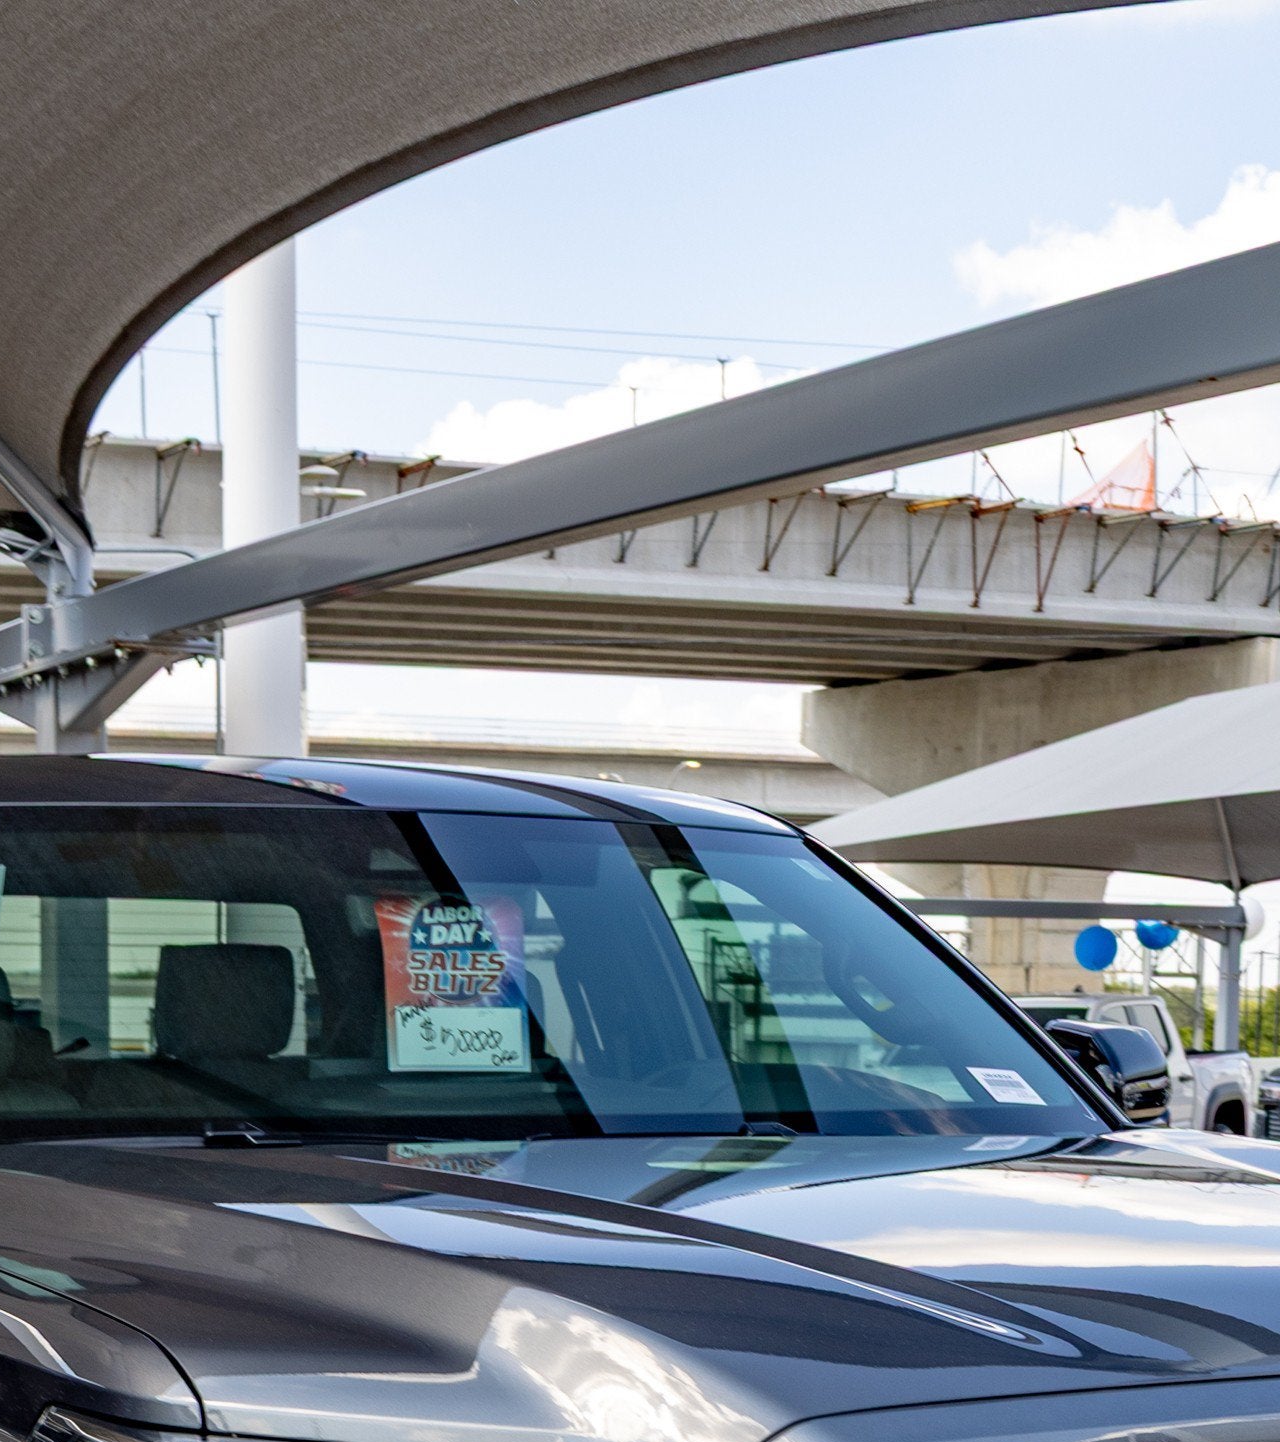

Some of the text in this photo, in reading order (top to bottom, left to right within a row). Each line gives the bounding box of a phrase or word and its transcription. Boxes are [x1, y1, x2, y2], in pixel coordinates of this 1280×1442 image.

[423, 906, 483, 924] LABOR
[430, 923, 478, 945] DAY
[409, 951, 506, 973] SALES
[410, 972, 501, 994] BLITZ
